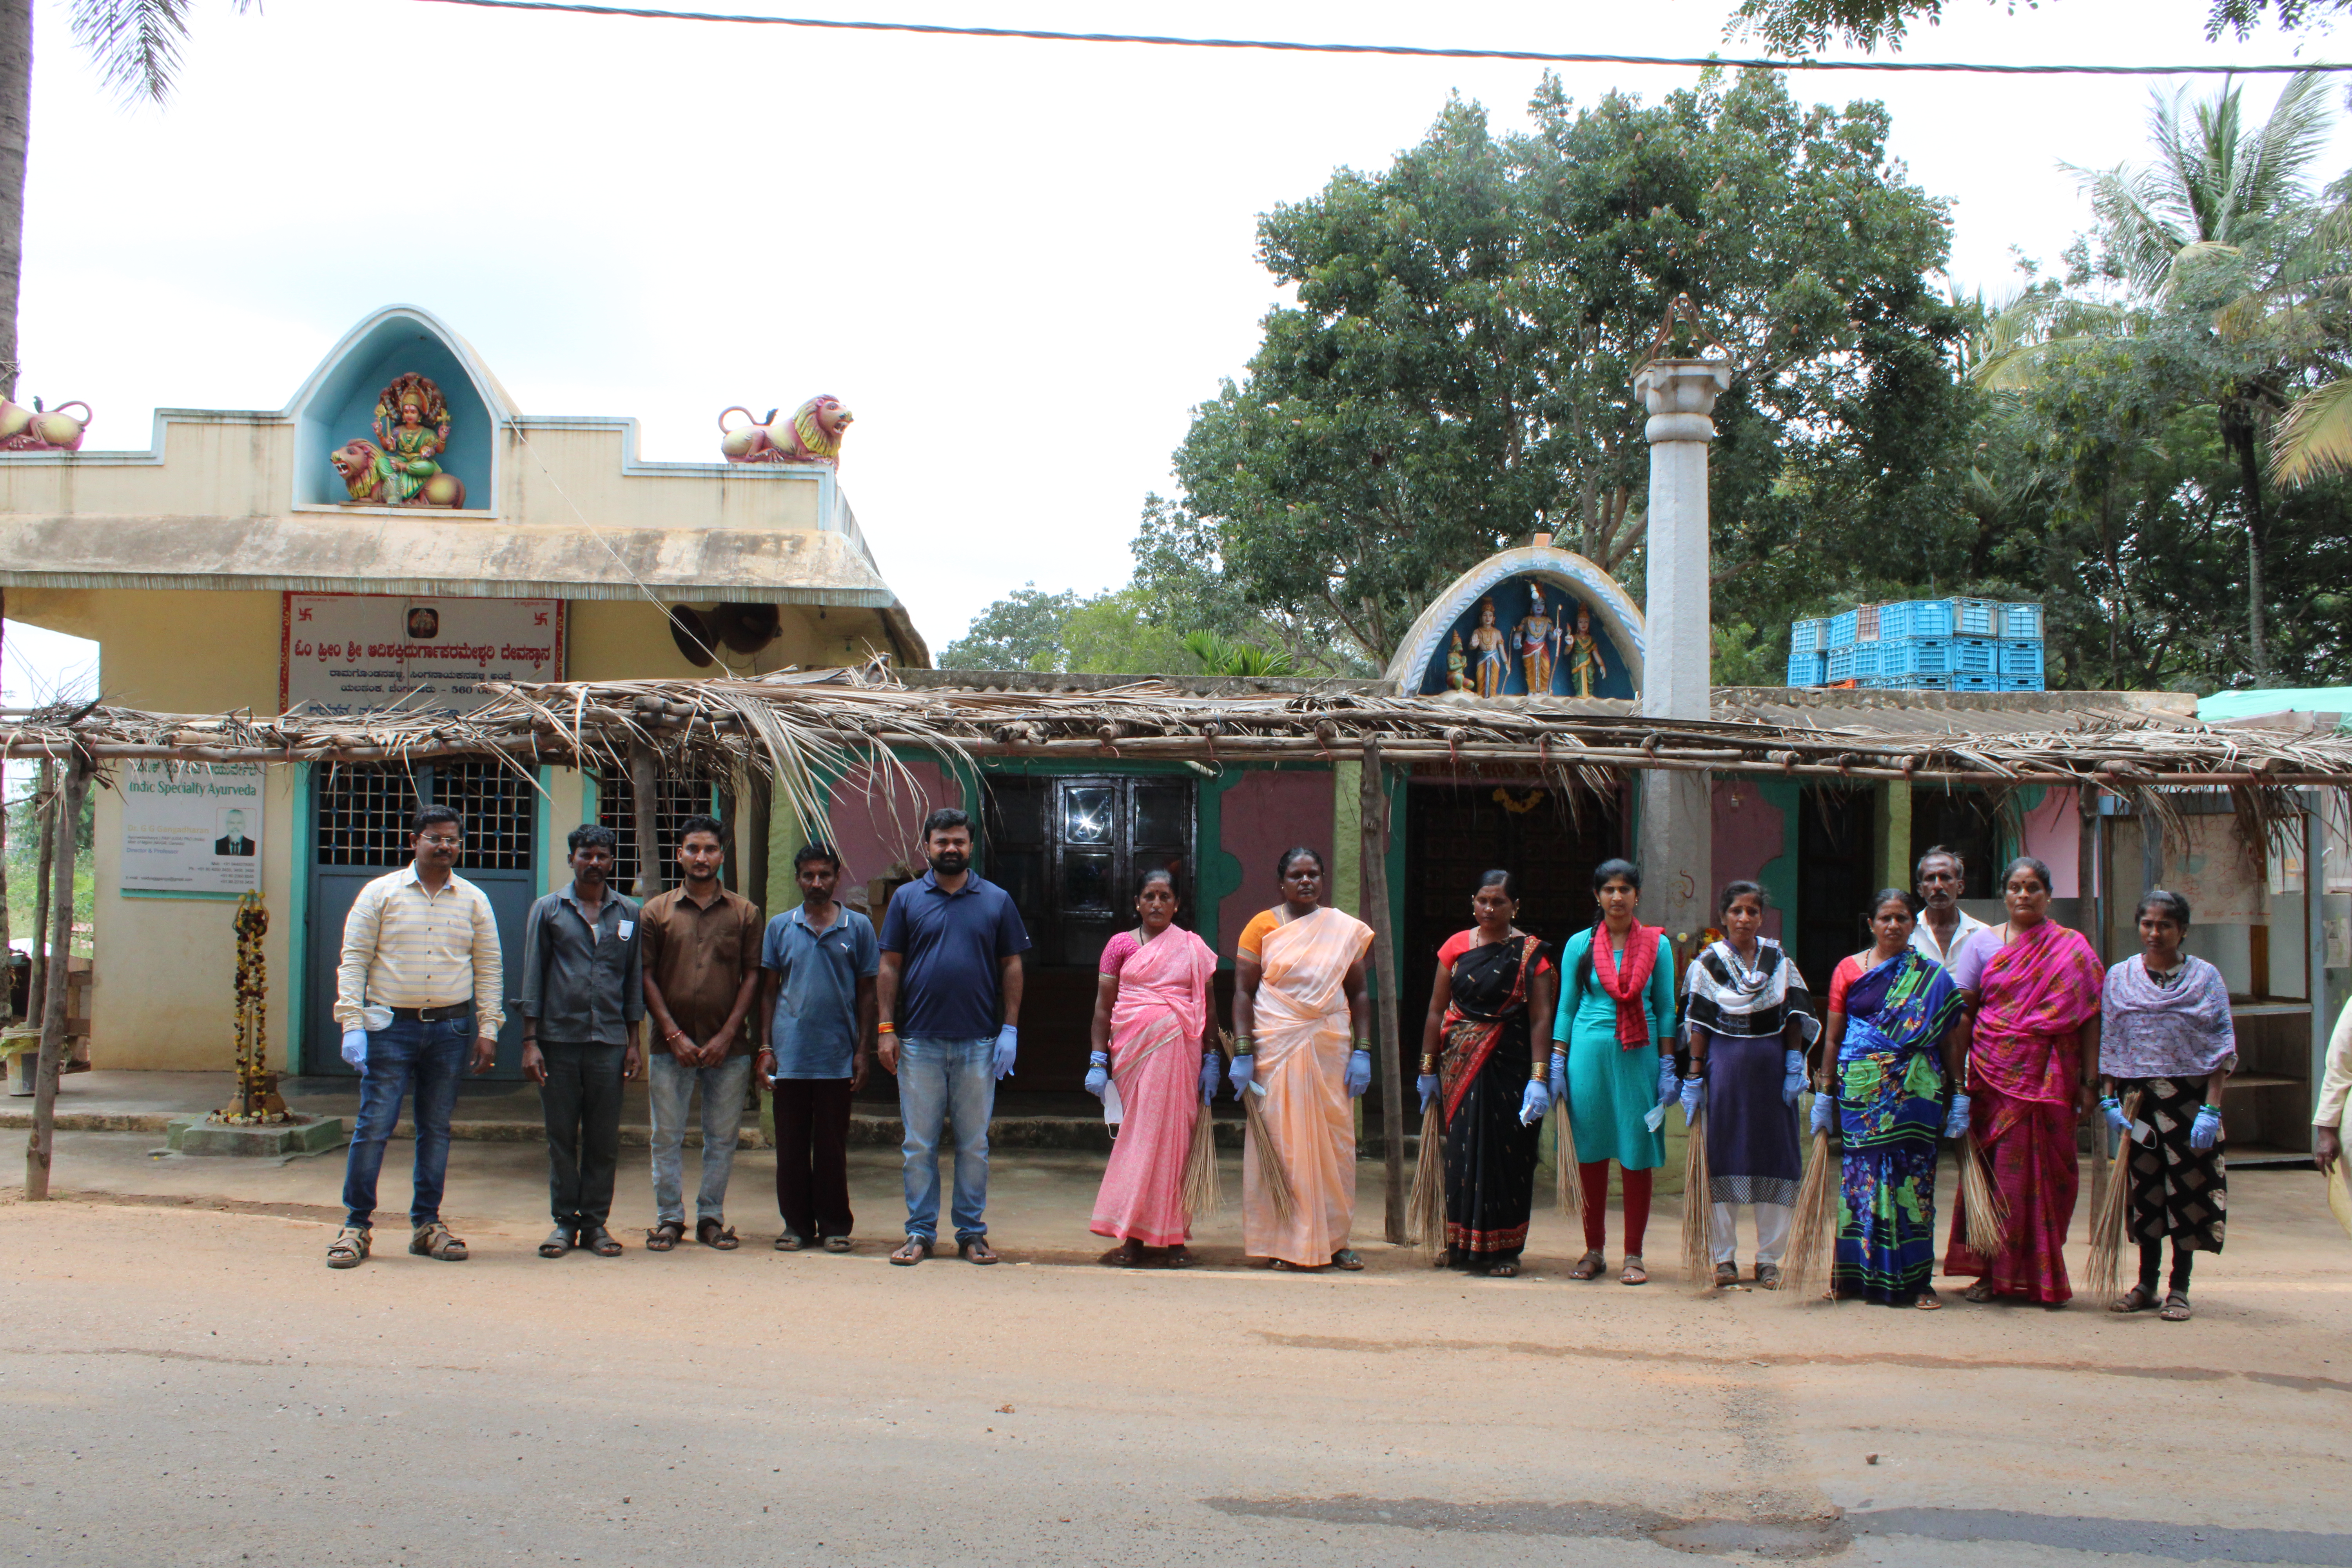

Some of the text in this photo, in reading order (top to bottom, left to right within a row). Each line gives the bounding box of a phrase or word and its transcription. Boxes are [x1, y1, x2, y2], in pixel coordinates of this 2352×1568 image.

[295, 639, 312, 656] ಓಂ
[318, 642, 341, 662] ಹ್ರೀಂ
[346, 641, 362, 662] ಶ್ರೀ
[501, 643, 550, 669] ದೇವಸ್ಥಾನ
[129, 781, 256, 797] Indic Specialty Ayurveda
[157, 826, 209, 834] Gangadharan
